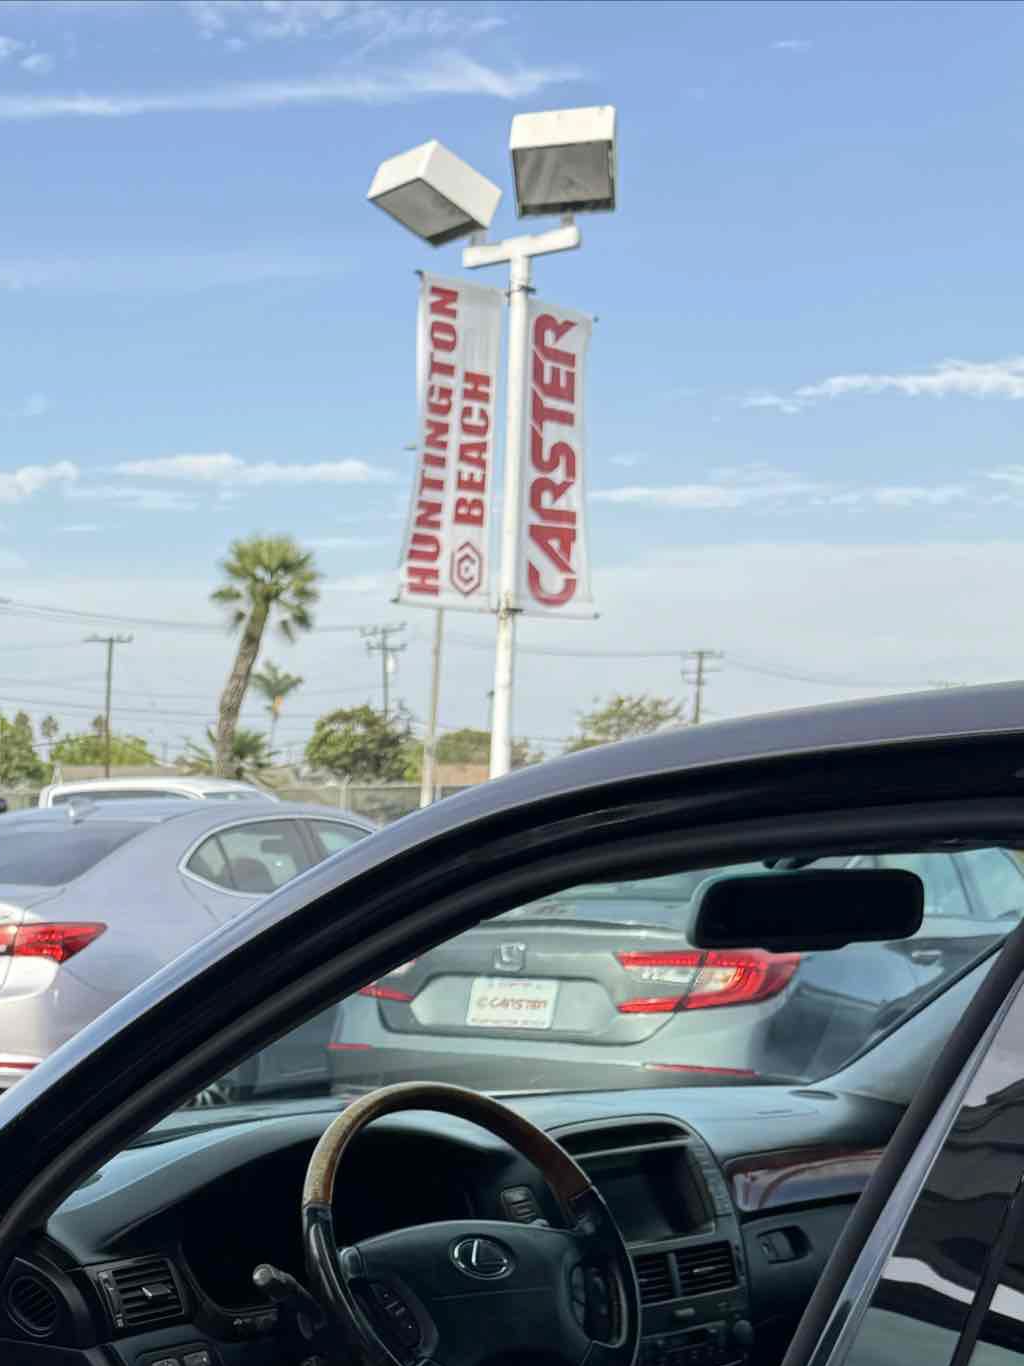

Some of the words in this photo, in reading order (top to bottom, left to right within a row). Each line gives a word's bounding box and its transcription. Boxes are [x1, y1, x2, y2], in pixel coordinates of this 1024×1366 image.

[407, 285, 459, 595] HUNTINGTON
[453, 371, 492, 528] BEACH
[527, 313, 578, 607] CARSTER
